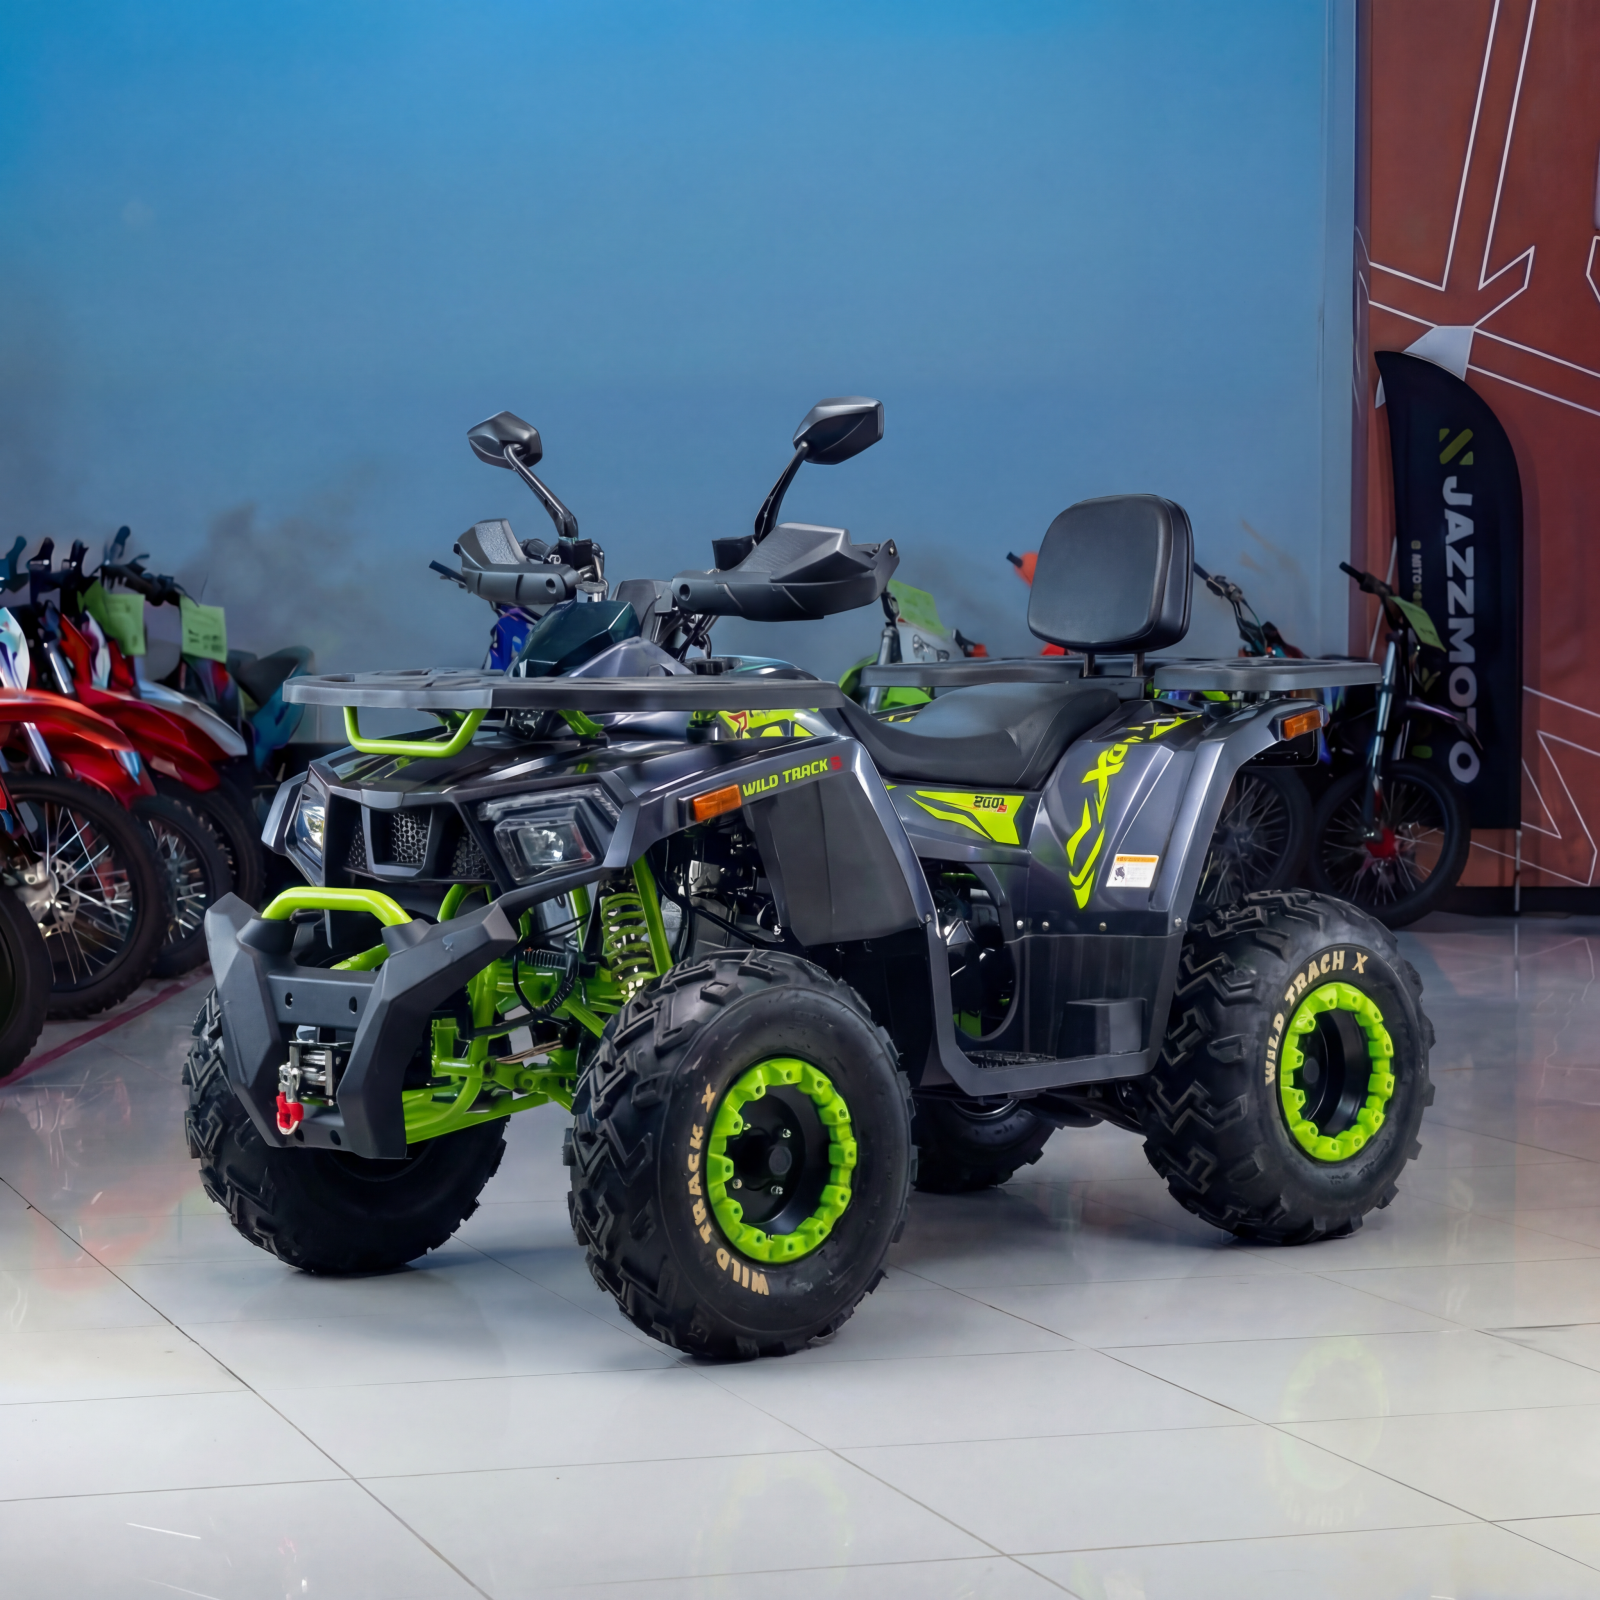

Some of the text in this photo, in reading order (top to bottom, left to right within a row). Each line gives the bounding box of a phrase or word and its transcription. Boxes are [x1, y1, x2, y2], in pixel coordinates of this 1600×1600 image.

[1442, 475, 1480, 784] JAZZMOTO
[742, 774, 779, 797] WILD
[782, 758, 828, 783] TRACK
[1265, 1013, 1284, 1087] WILD
[1352, 952, 1368, 974] X
[687, 1083, 770, 1296] WILD TRACK X
